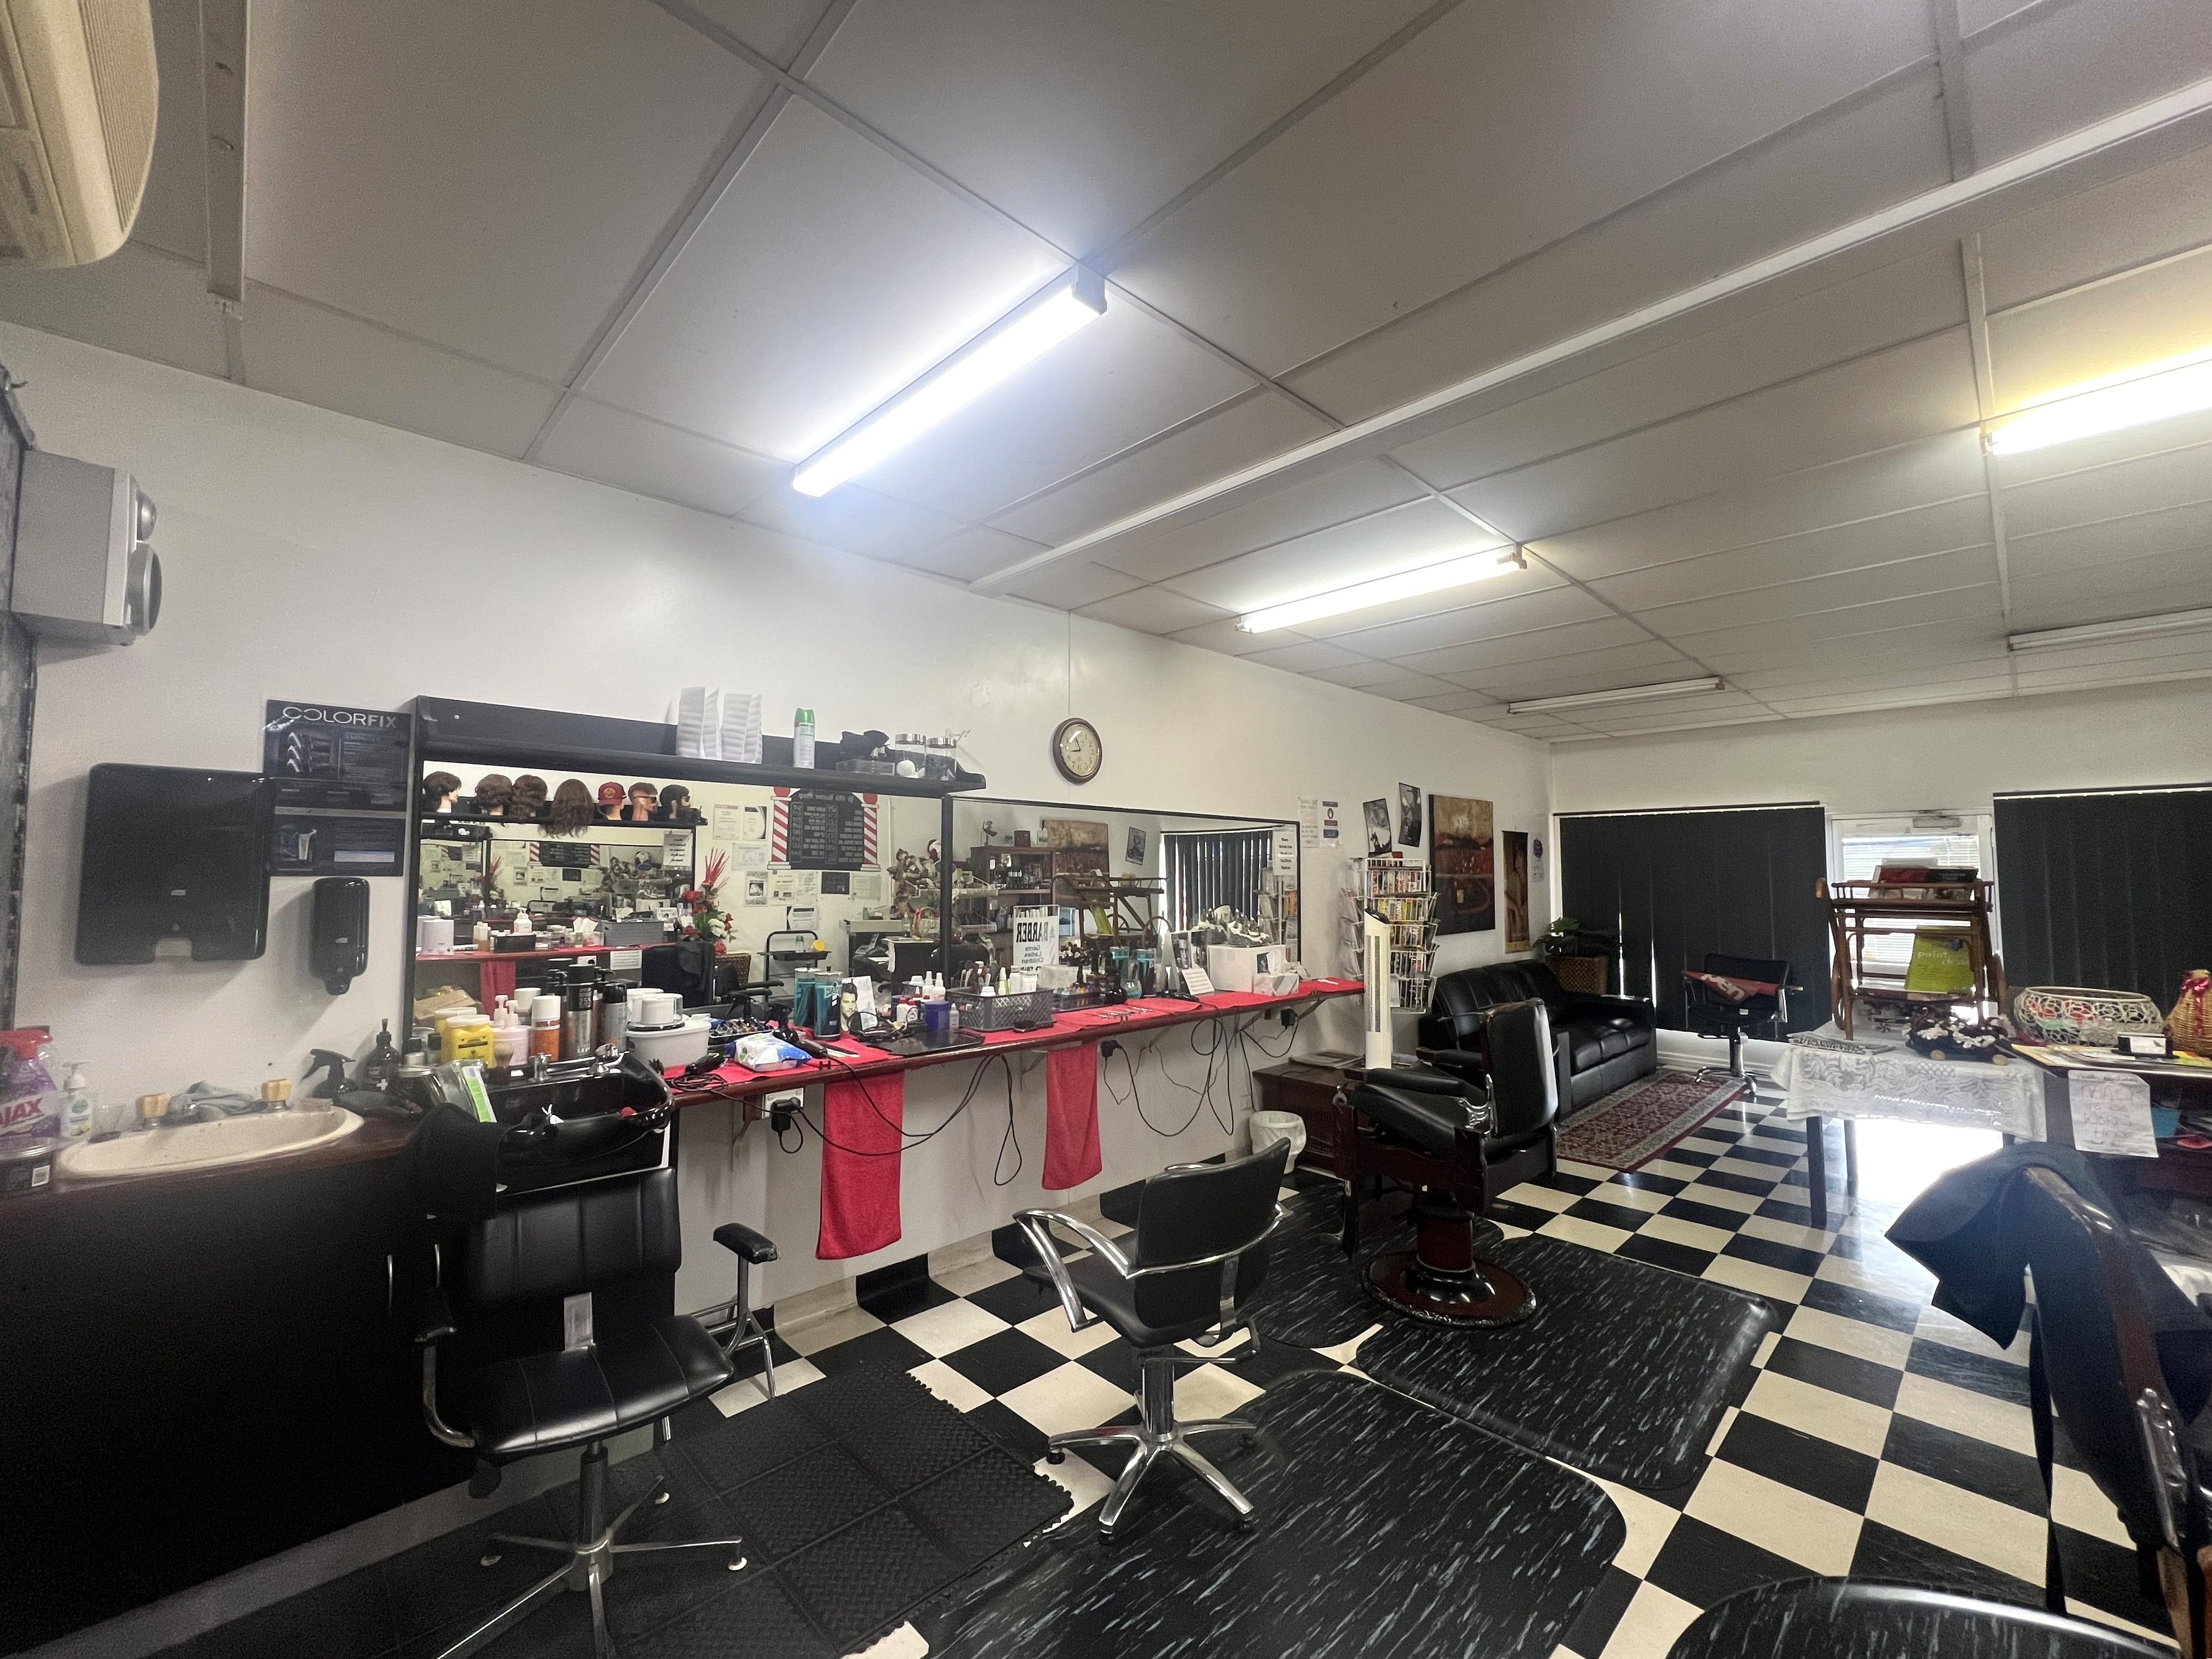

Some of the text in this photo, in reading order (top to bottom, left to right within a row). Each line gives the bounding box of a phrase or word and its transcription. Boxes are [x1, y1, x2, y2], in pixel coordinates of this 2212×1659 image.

[282, 706, 397, 728] COLORFIX
[1917, 950, 1948, 959] paint
[0, 1097, 43, 1128] JAX
